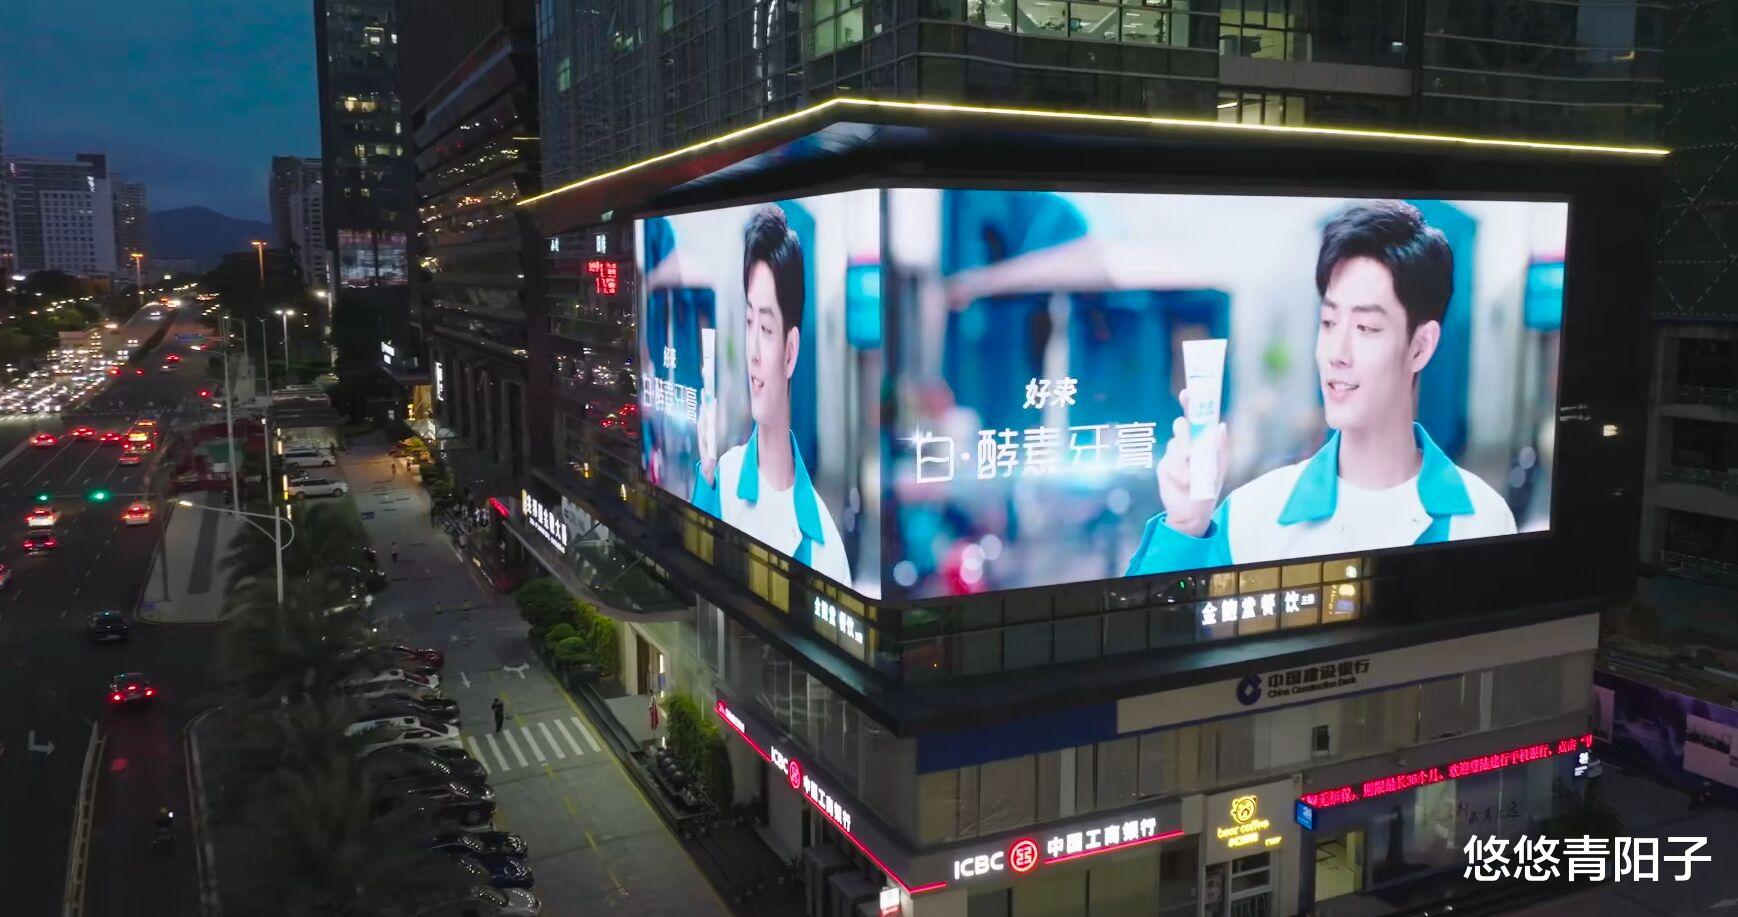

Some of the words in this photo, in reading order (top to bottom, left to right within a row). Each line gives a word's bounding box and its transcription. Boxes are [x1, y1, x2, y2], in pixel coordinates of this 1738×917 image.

[1023, 376, 1078, 409] 好来
[1268, 658, 1370, 688] 中国建设银行
[953, 851, 1005, 880] ICBC
[1047, 817, 1157, 858] 中国工商银行
